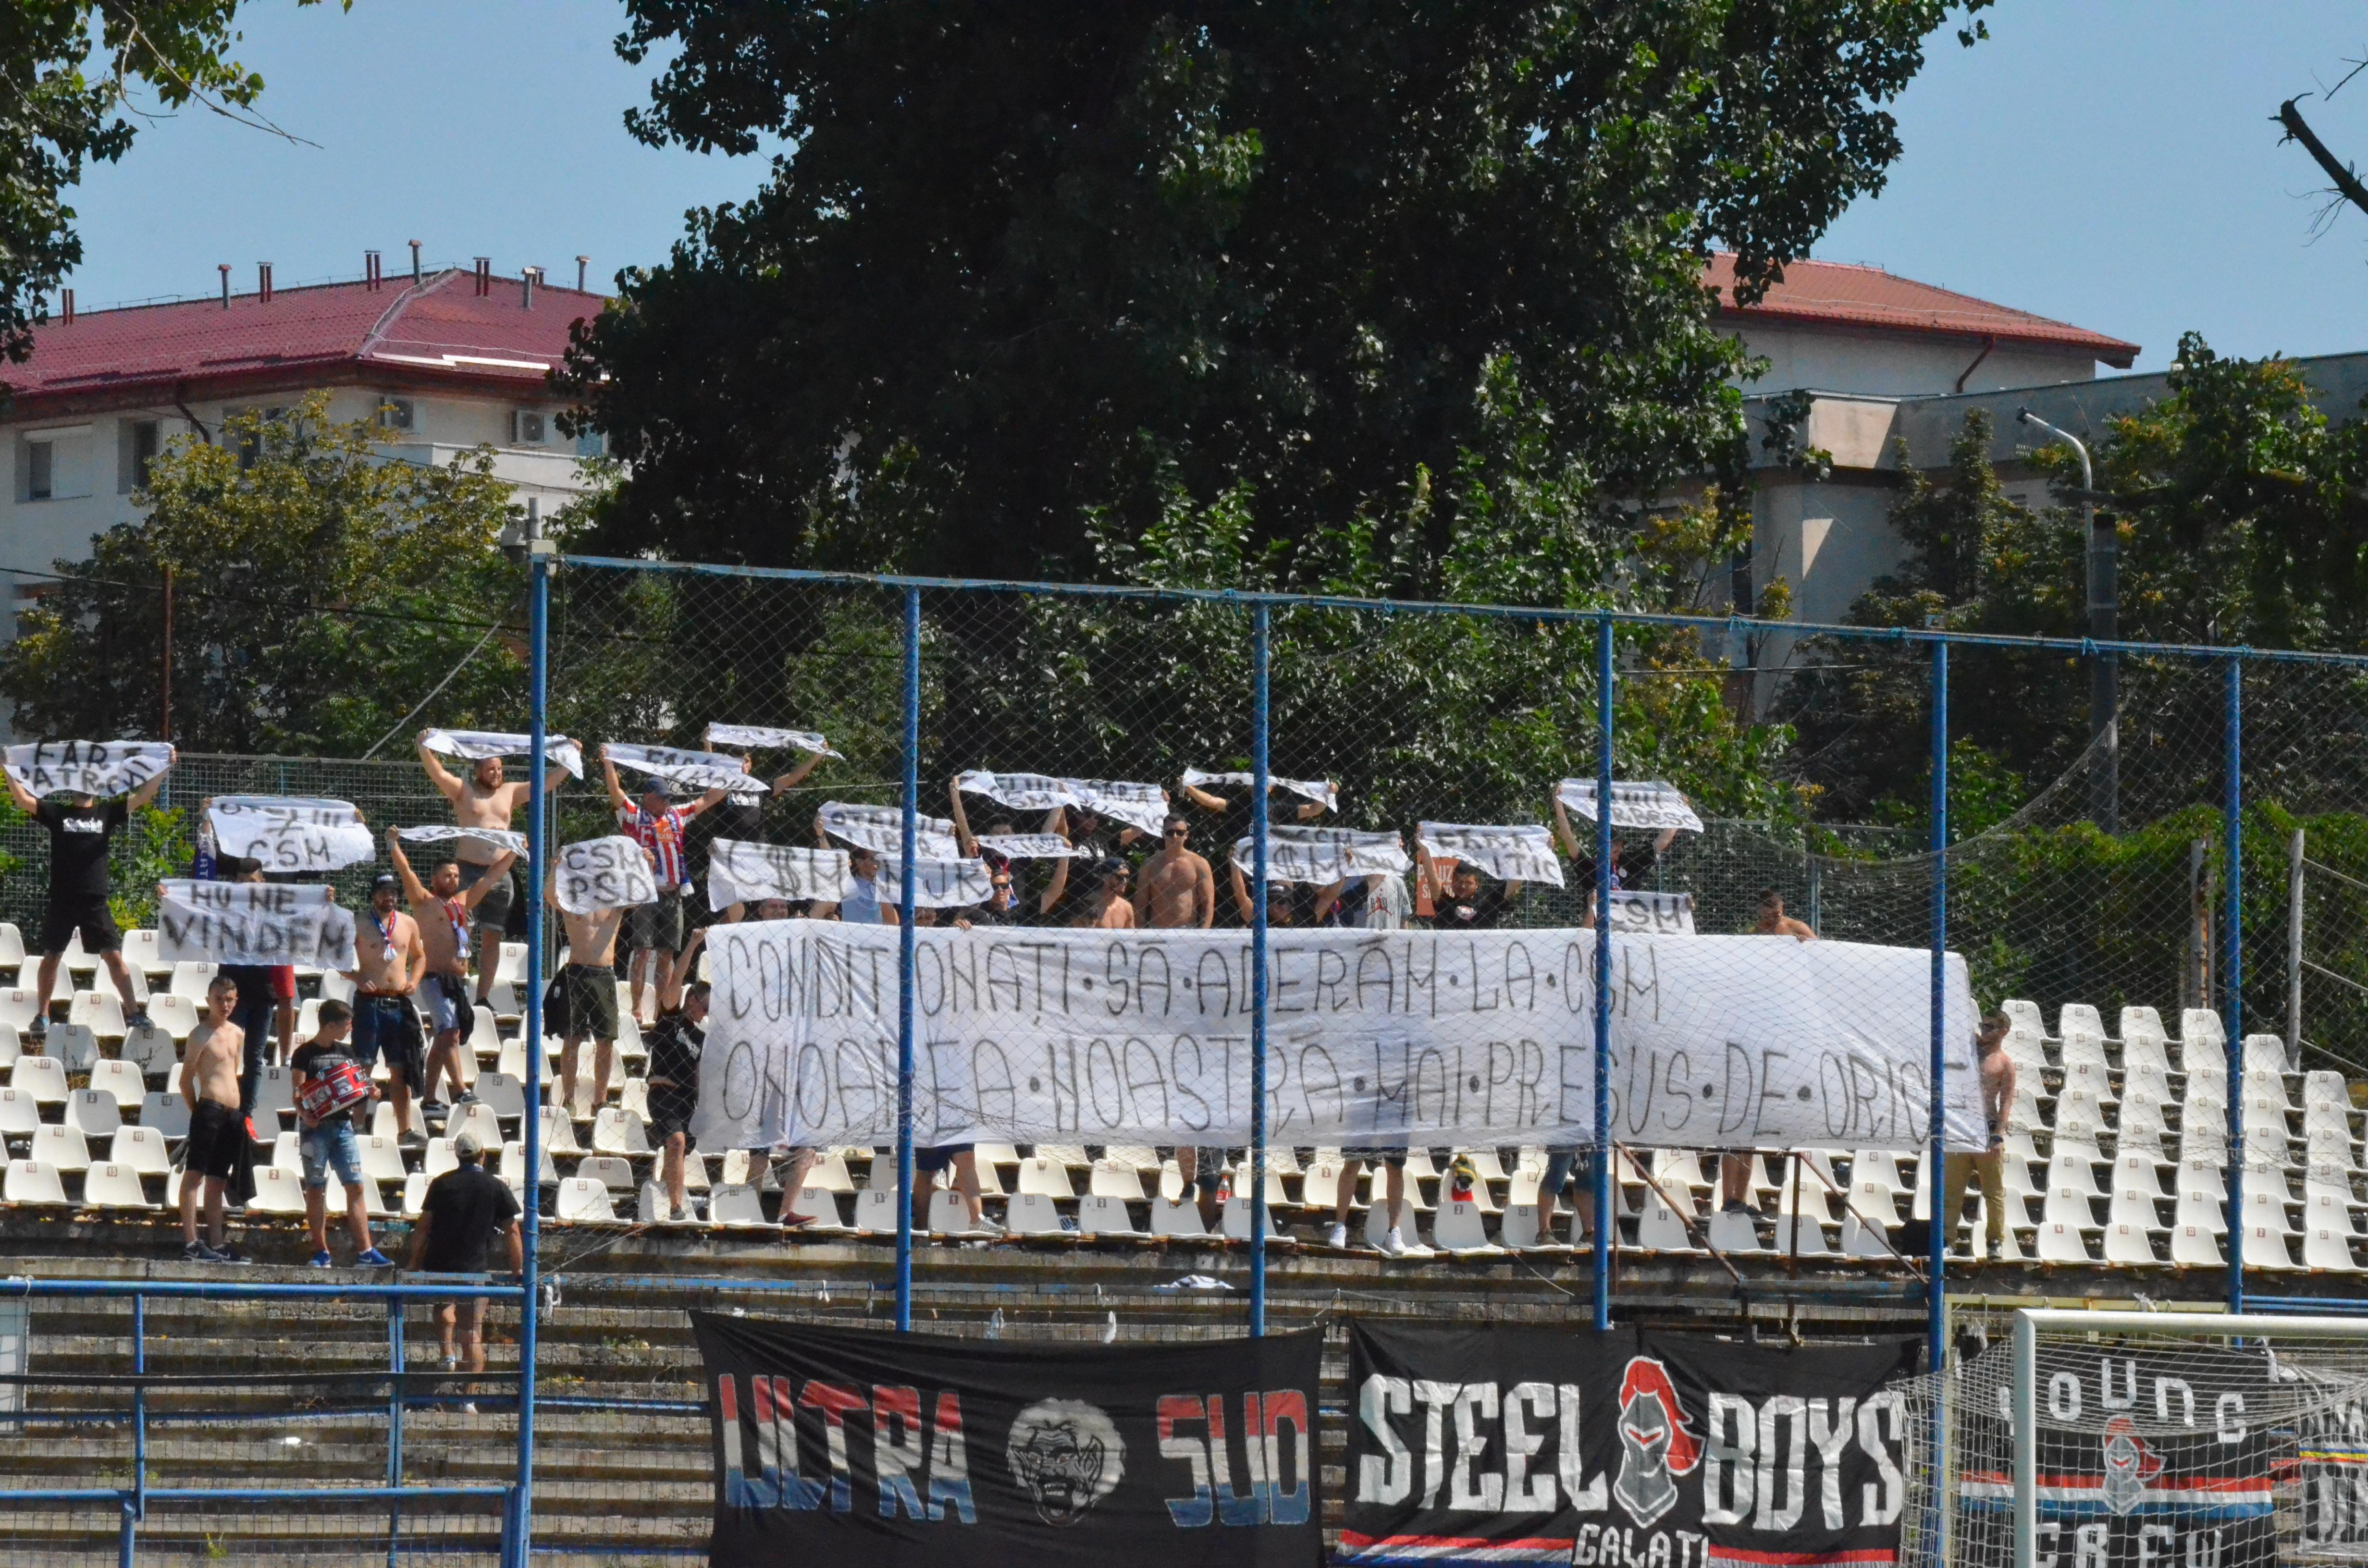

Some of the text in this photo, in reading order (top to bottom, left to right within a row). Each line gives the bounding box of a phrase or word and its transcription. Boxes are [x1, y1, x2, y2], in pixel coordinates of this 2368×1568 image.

[247, 838, 331, 867] CSM
[566, 844, 644, 872] CSM
[250, 886, 297, 914] NE
[567, 871, 651, 904] PSD
[162, 915, 346, 960] VINDEM
[198, 964, 207, 972] 21
[728, 934, 1069, 1025] CONDITONAȚI
[1470, 941, 1535, 1011] LA
[166, 997, 175, 1006] 20
[1373, 1041, 1461, 1128] MAI
[1718, 1041, 1788, 1137] DE
[372, 1138, 382, 1147] 20
[578, 1181, 587, 1190] 22
[718, 1373, 1310, 1528] ULTRA SUD
[1355, 1374, 1906, 1532] STEEL BOYS
